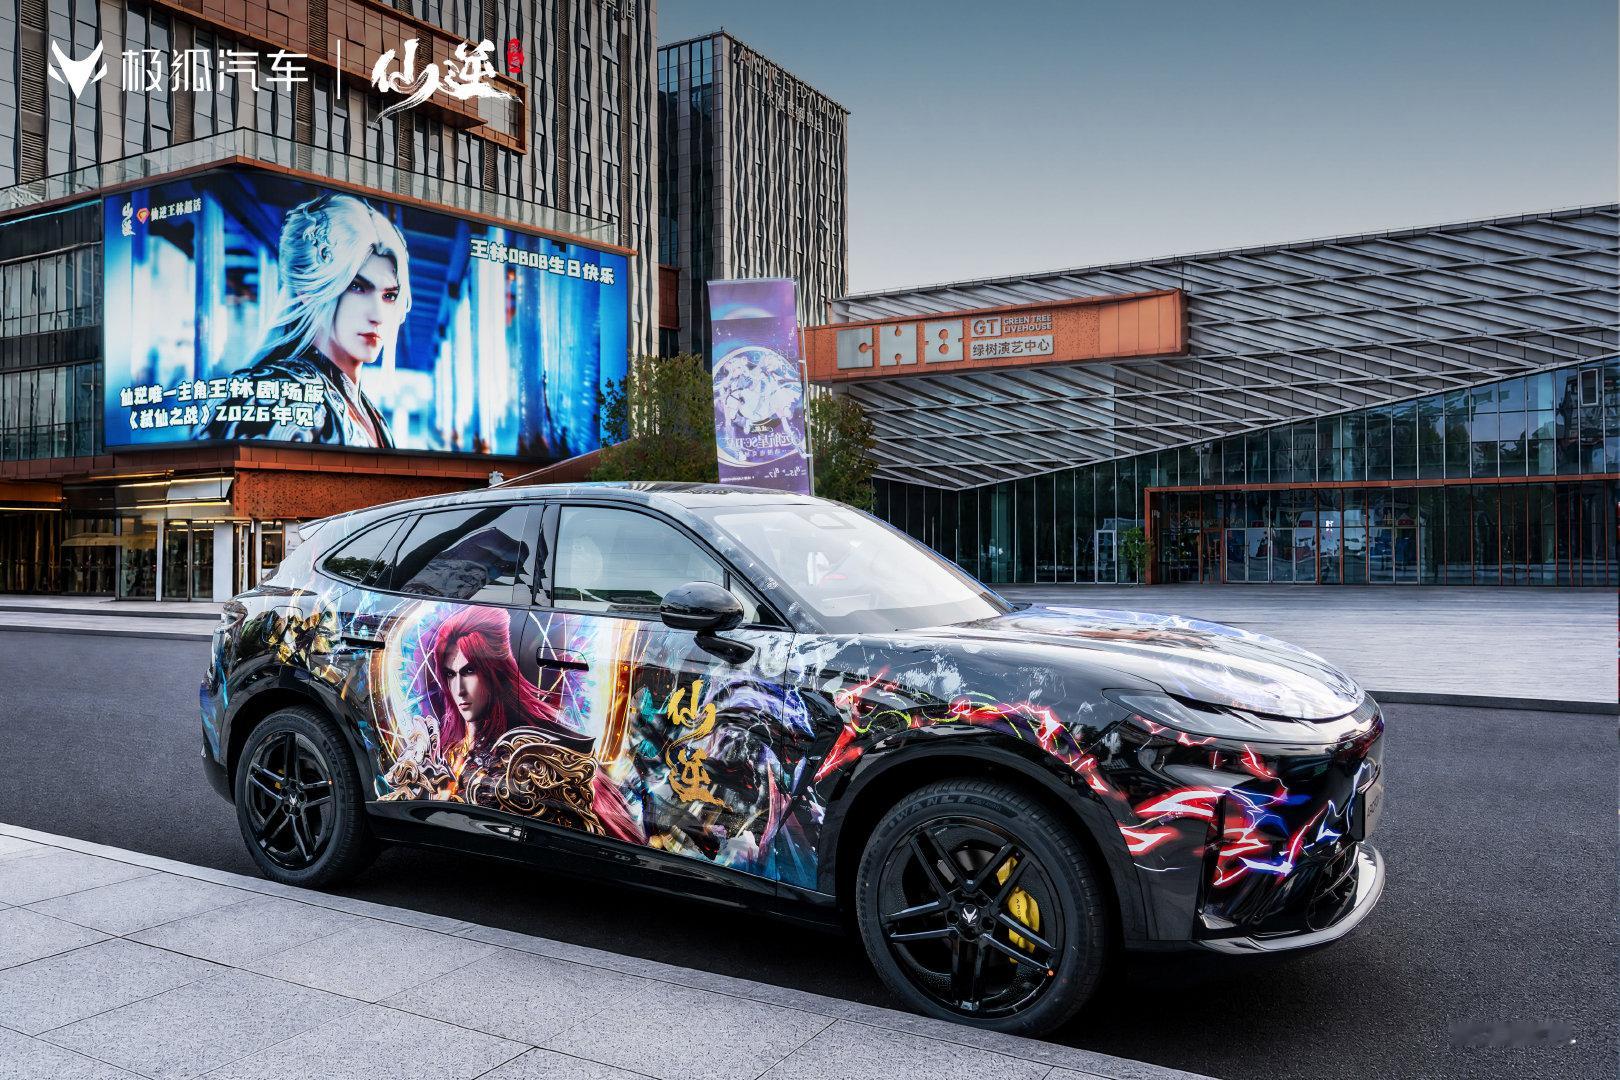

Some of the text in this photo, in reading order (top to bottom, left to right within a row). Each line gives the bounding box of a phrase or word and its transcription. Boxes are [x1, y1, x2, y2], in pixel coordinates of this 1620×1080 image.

[470, 239, 615, 285] 王林0808生日快乐
[973, 319, 999, 336] GT
[1004, 315, 1052, 325] GREEN TREE
[1004, 323, 1052, 333] LIVEHOUSE
[972, 338, 1050, 356] 绿树演艺中心
[120, 378, 325, 408] 仙逆唯一主角王林剧场版
[665, 679, 733, 813] 仙逆
